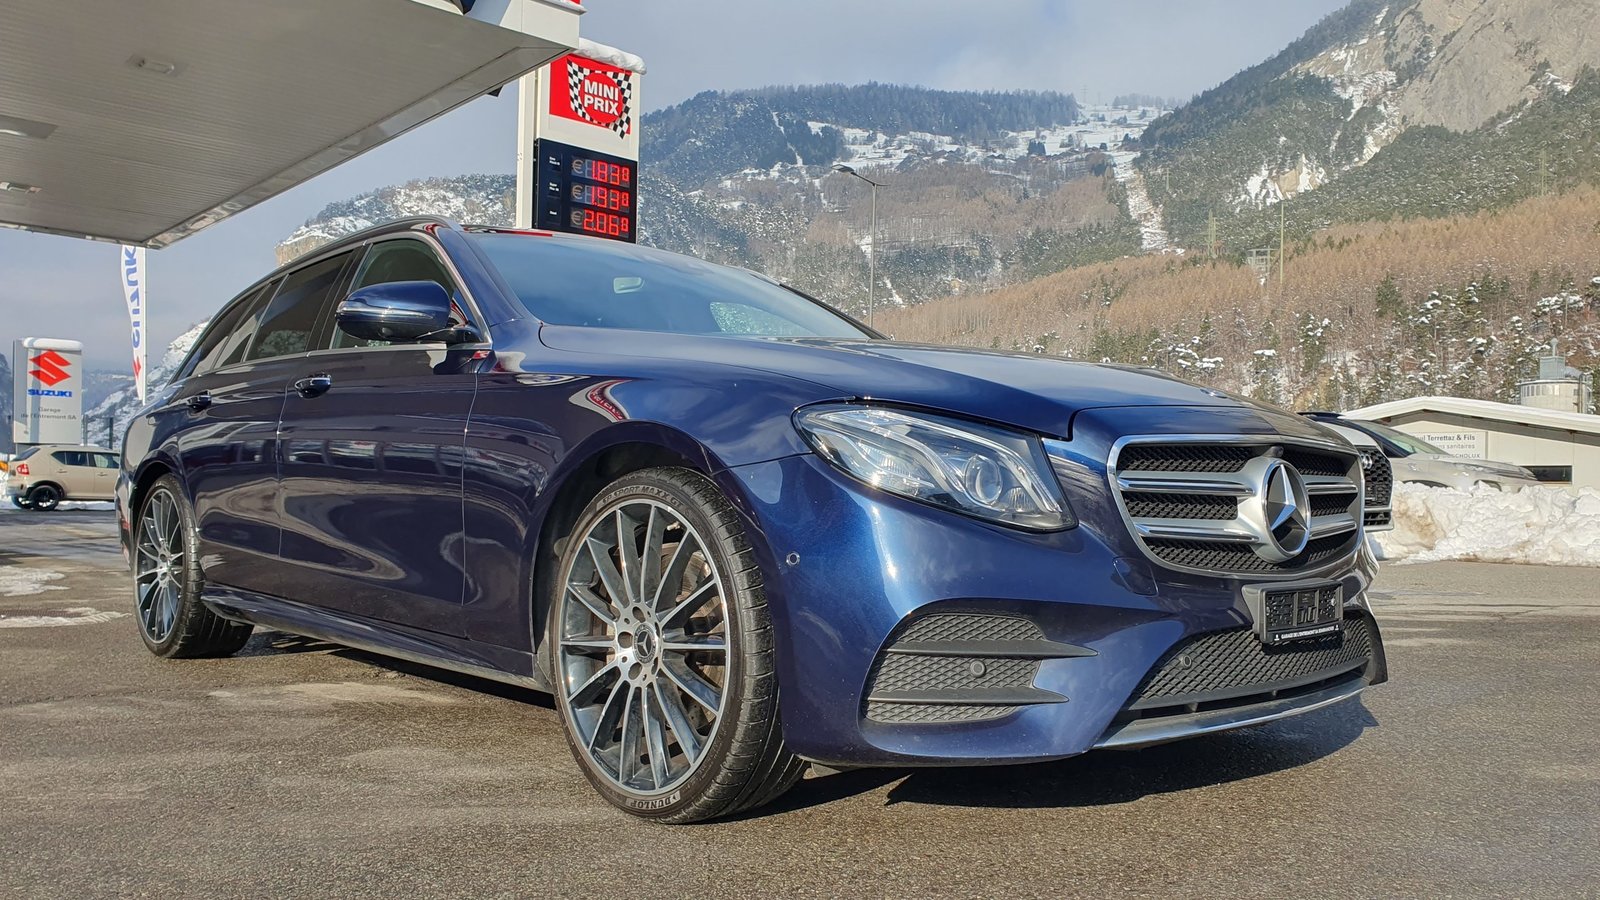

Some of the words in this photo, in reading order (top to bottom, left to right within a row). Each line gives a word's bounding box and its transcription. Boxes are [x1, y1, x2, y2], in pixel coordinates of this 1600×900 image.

[584, 79, 619, 101] MINI
[584, 95, 619, 116] PRIX
[28, 389, 72, 397] SUZUKI
[613, 486, 640, 497] SPORT
[641, 486, 669, 499] MAXX
[669, 497, 683, 507] GT
[631, 797, 671, 809] DUNLOP
